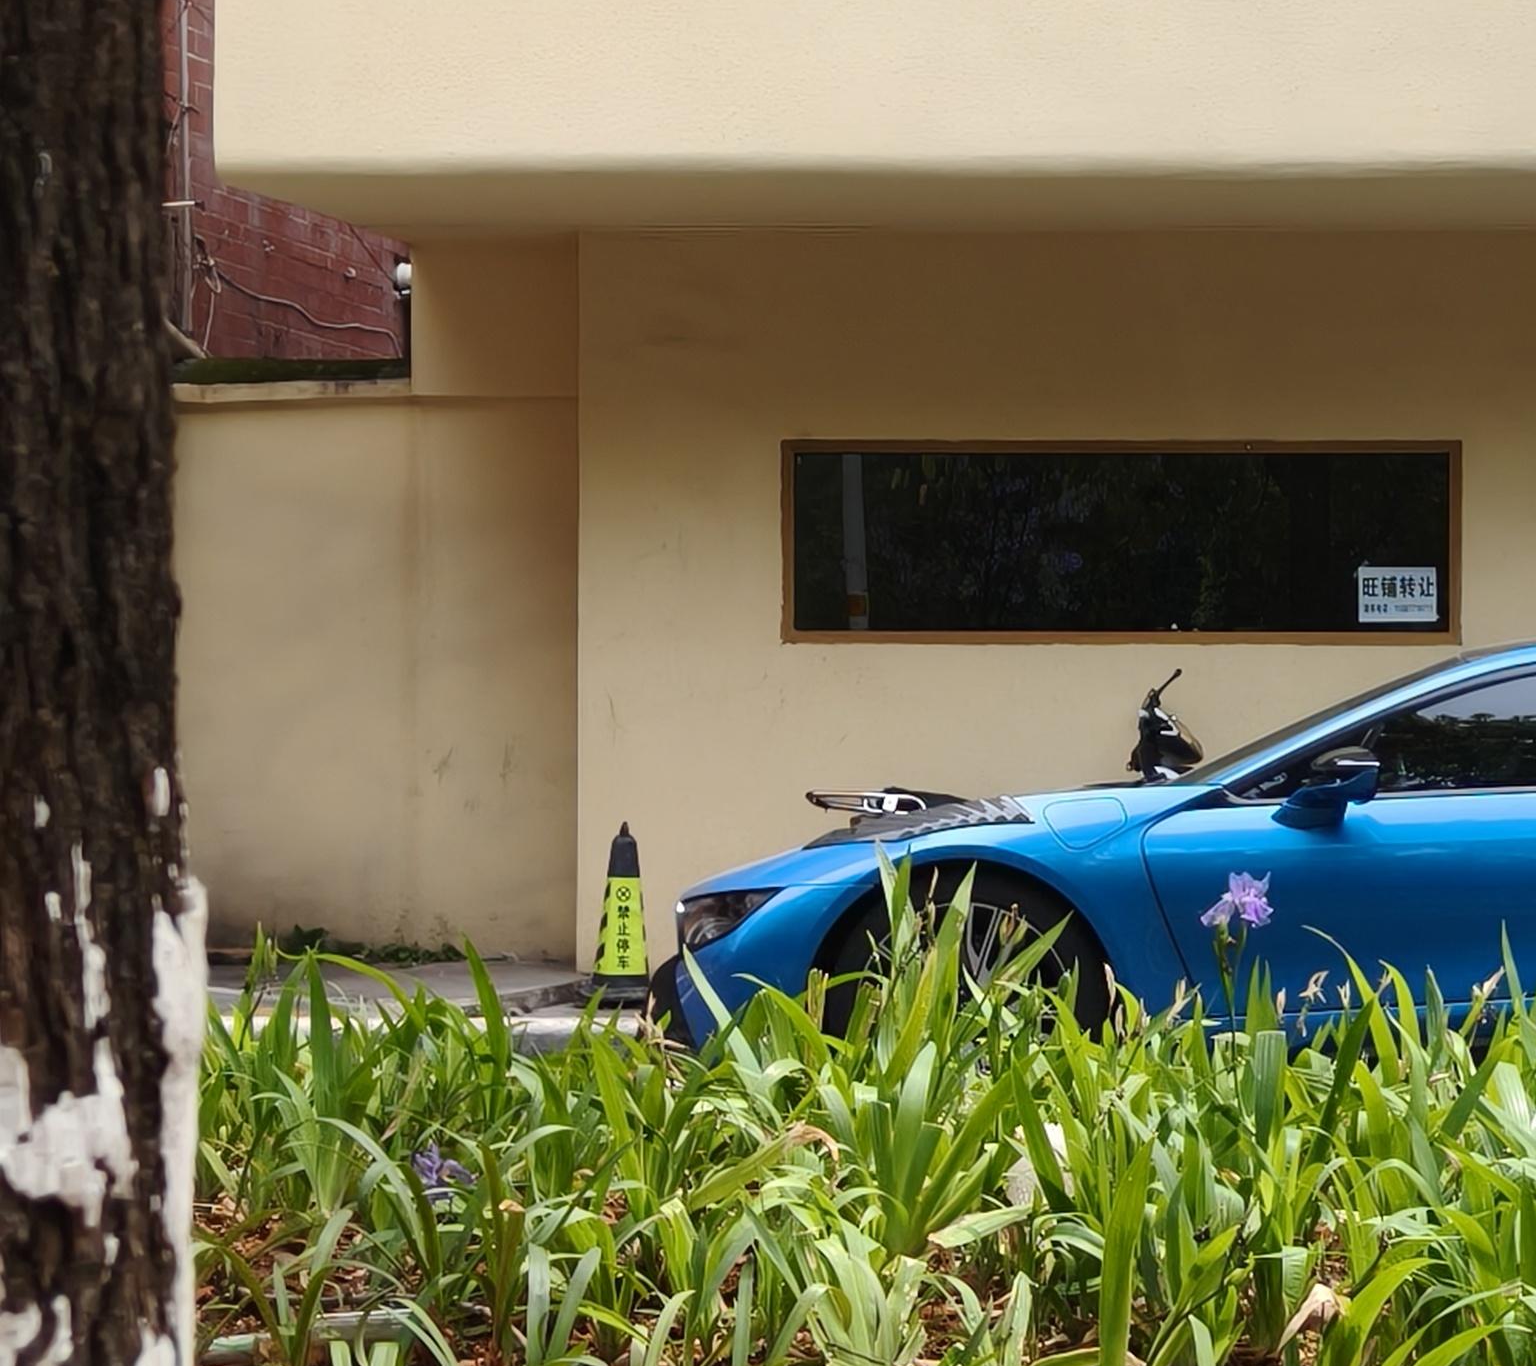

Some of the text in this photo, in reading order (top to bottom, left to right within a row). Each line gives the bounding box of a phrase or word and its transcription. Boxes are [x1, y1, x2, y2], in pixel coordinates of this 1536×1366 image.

[1362, 576, 1434, 598] 旺铺转让
[617, 905, 631, 970] 禁止停车
